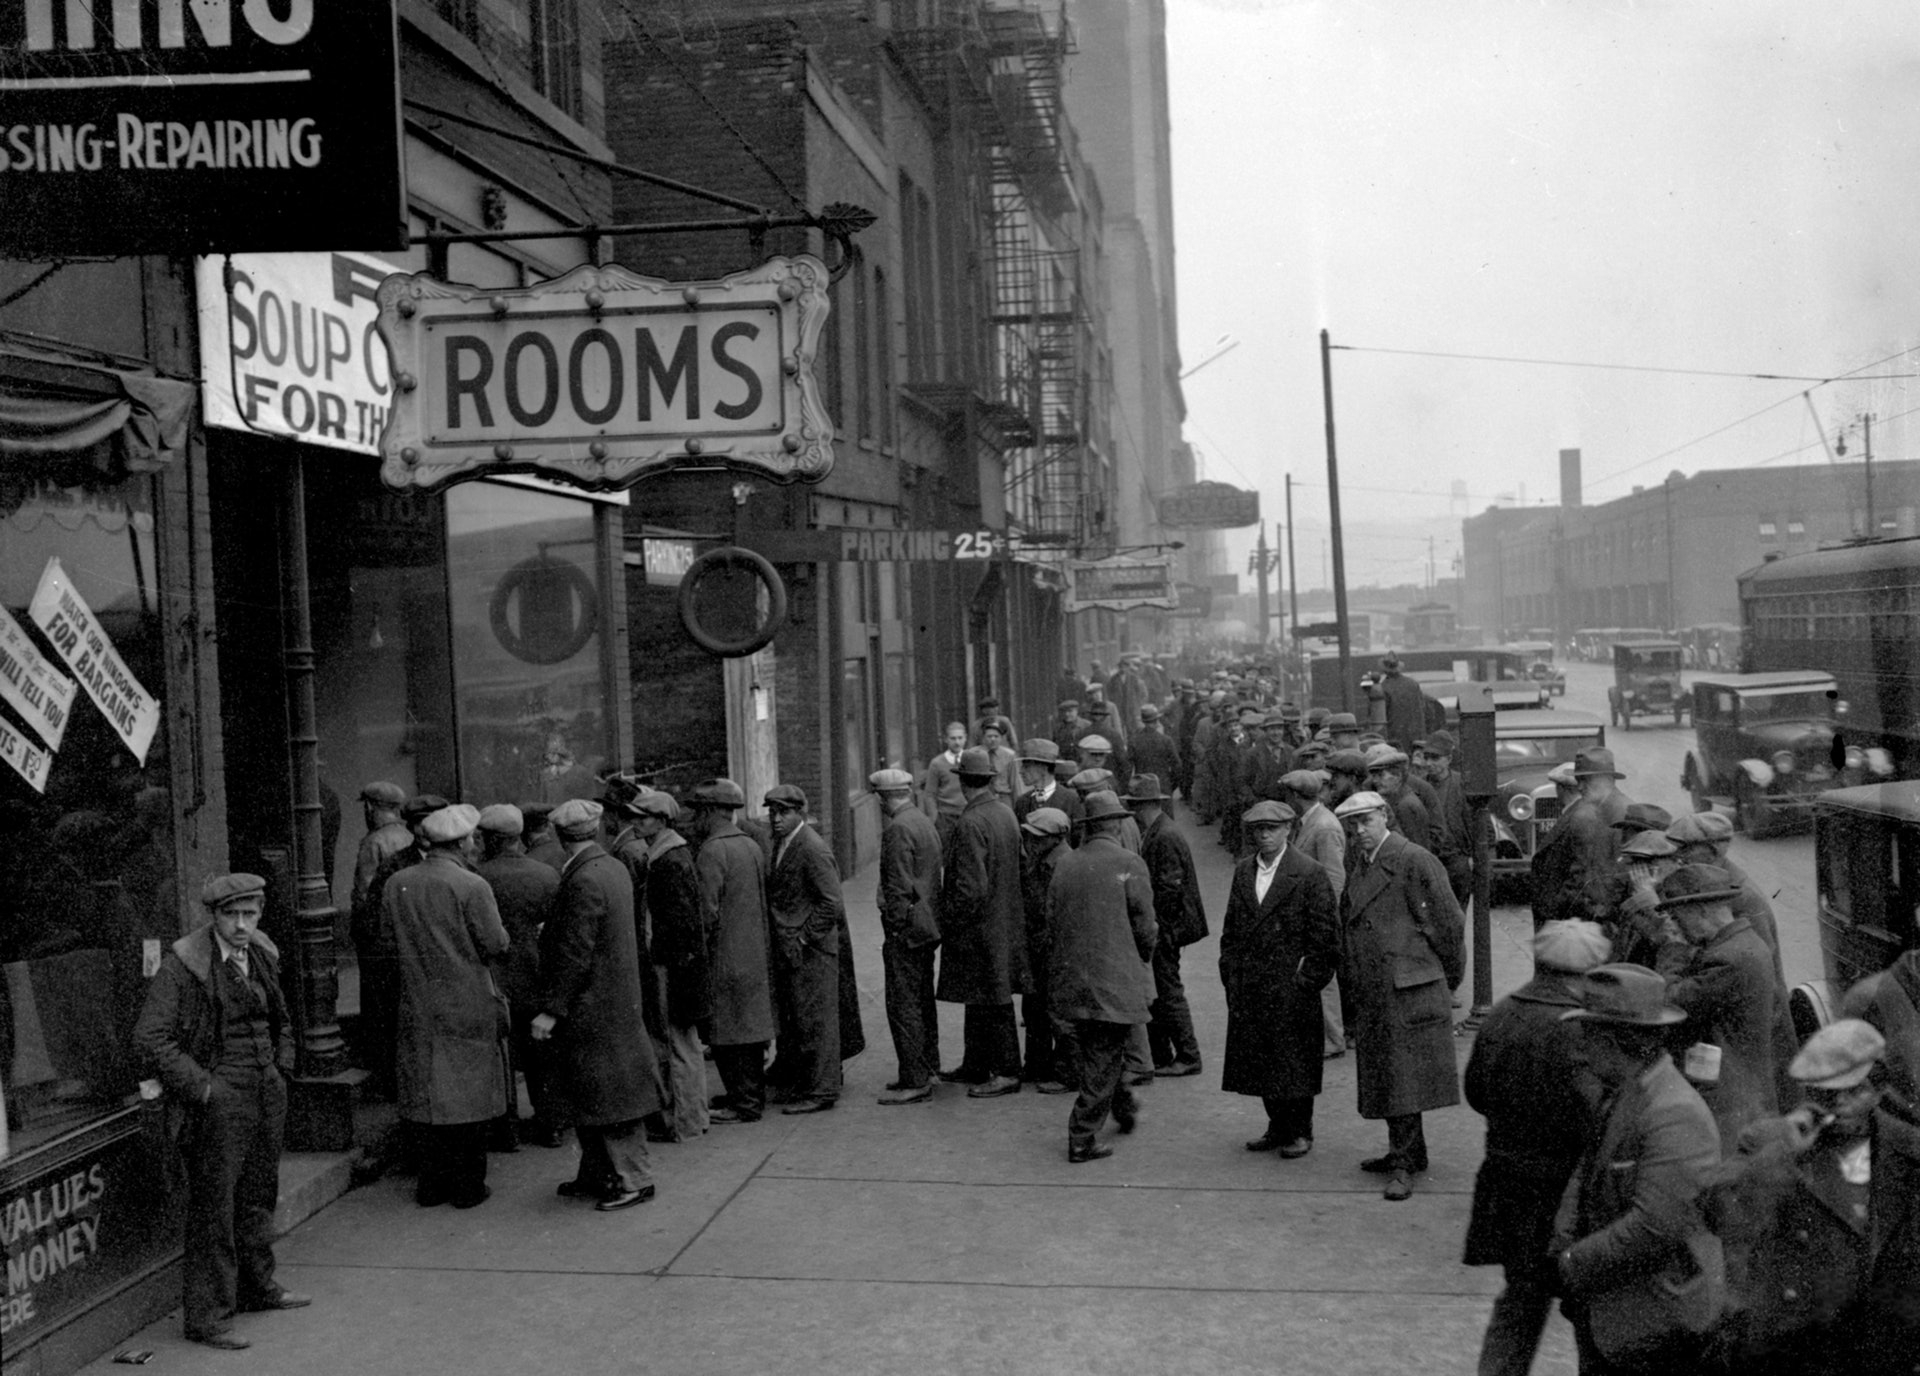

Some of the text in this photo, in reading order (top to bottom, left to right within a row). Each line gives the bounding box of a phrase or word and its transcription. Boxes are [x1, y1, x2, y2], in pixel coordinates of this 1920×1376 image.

[229, 269, 352, 382] SOUP
[244, 373, 391, 447] FOR TH
[445, 321, 763, 429] ROOMS
[841, 530, 949, 561] PARKING
[45, 612, 136, 737] FOR BARGAINS
[57, 589, 143, 710] WATCH OUR WINDOWS
[20, 674, 48, 710] TELL
[42, 701, 65, 730] YOU
[0, 1162, 105, 1246] VALUES
[7, 1213, 101, 1296] MONEY
